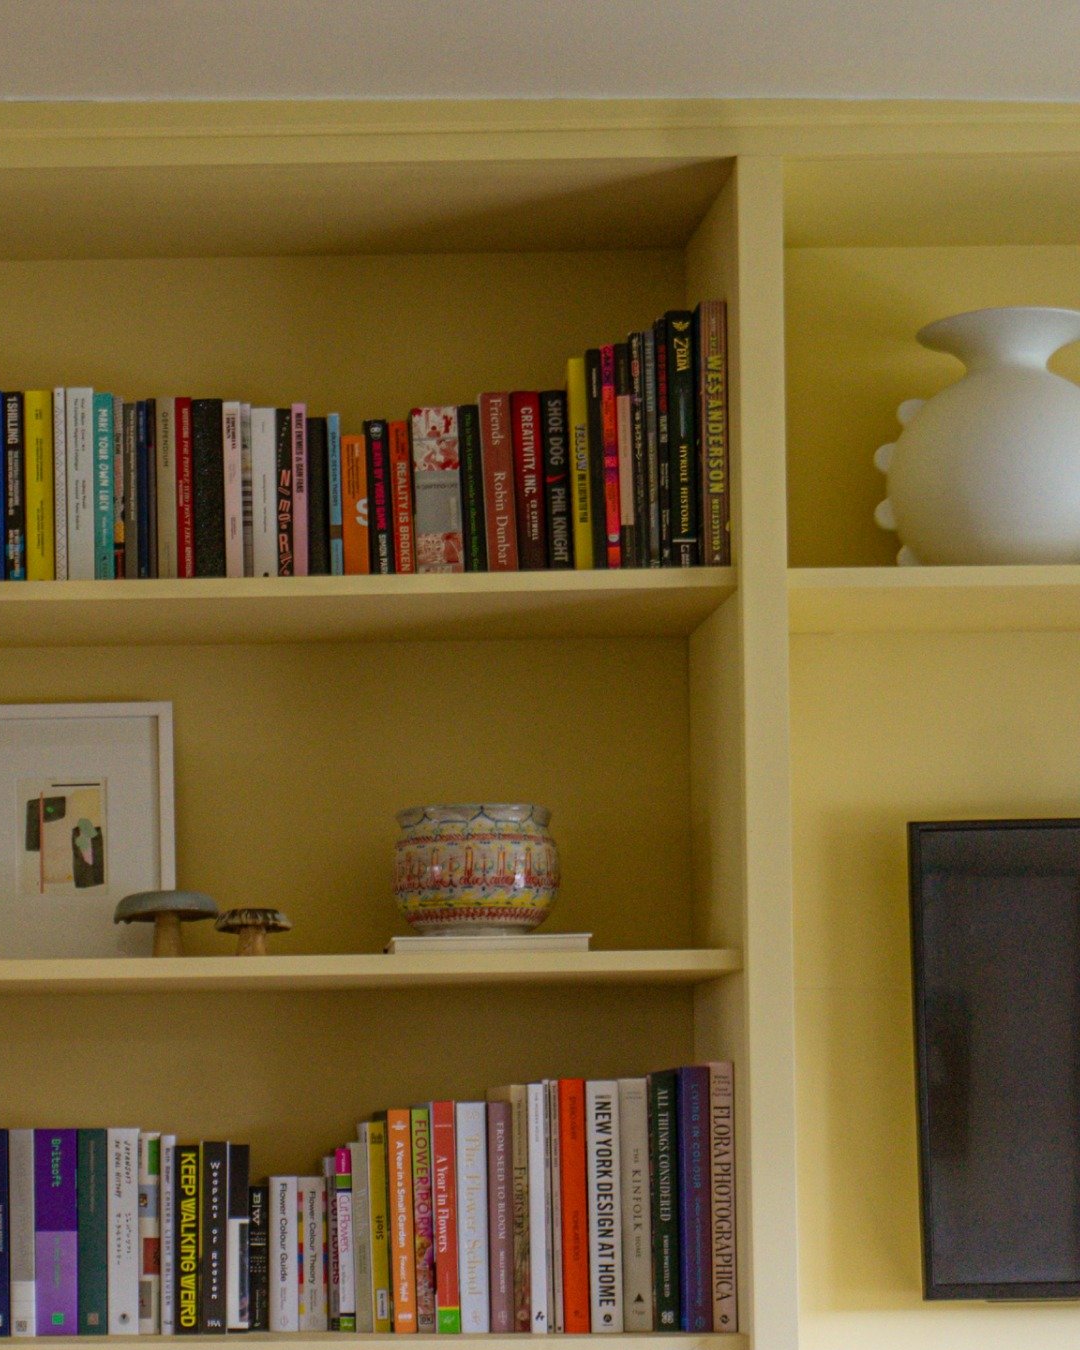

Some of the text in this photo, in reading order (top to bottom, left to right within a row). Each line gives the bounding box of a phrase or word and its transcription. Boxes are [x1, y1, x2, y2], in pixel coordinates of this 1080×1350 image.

[7, 403, 18, 444] SHILLING
[98, 408, 109, 432] MAKE
[295, 430, 304, 455] ENEMIES
[490, 398, 504, 446] Friends
[707, 354, 724, 494] WES ANDERSON
[98, 436, 109, 460] YOUR
[182, 456, 190, 483] PEOPLE
[296, 464, 304, 478] GAIN
[520, 406, 536, 498] CREATIVITY, INC.
[575, 424, 588, 471] YELLOW
[98, 464, 109, 486] OWN
[296, 478, 304, 494] FANS
[371, 442, 386, 530] DEATH BY VIDEO GAME
[396, 462, 408, 509] REALITY
[547, 400, 568, 562] SHOE DOG PHIL KNIGHT
[680, 445, 689, 534] HYRULE HISTORIA
[98, 490, 109, 511] LUCK
[398, 512, 409, 522] IS
[493, 472, 510, 565] Robin Dunbar
[530, 500, 537, 508] ED
[712, 498, 720, 551] COLLECTION
[184, 547, 192, 578] ADVERTISING
[398, 526, 411, 572] BROKEN
[691, 1084, 699, 1121] LIVING
[496, 1122, 504, 1152] FROM
[692, 1126, 700, 1136] IN
[713, 1105, 730, 1158] FLORA
[51, 1138, 62, 1188] Britsoft
[396, 1151, 404, 1170] Year
[396, 1172, 404, 1180] in
[415, 1120, 430, 1237] FLOWER PORN
[657, 1088, 671, 1222] ALL THINGS CONSIDERED
[692, 1142, 700, 1188] COLOUR
[210, 1162, 220, 1219] Weapons
[397, 1189, 405, 1212] Small
[436, 1155, 449, 1253] A Year in Flowers
[498, 1186, 505, 1200] TO
[514, 1166, 526, 1238] FLORISTRY
[595, 1101, 615, 1307] NEW YORK DESIGN AT HOME
[632, 1170, 642, 1232] KINFOLK
[211, 1228, 218, 1244] of
[280, 1183, 288, 1282] Flower Colour Guide
[308, 1191, 316, 1284] Flower Colour Theory
[338, 1195, 350, 1253] Cut Flowers
[398, 1215, 406, 1248] Garden
[464, 1133, 482, 1296] The Flower School
[498, 1202, 506, 1240] BLOOM
[714, 1162, 732, 1302] PHOTOGRAPHICA
[180, 1153, 196, 1327] KEEP WALKING WEIRD
